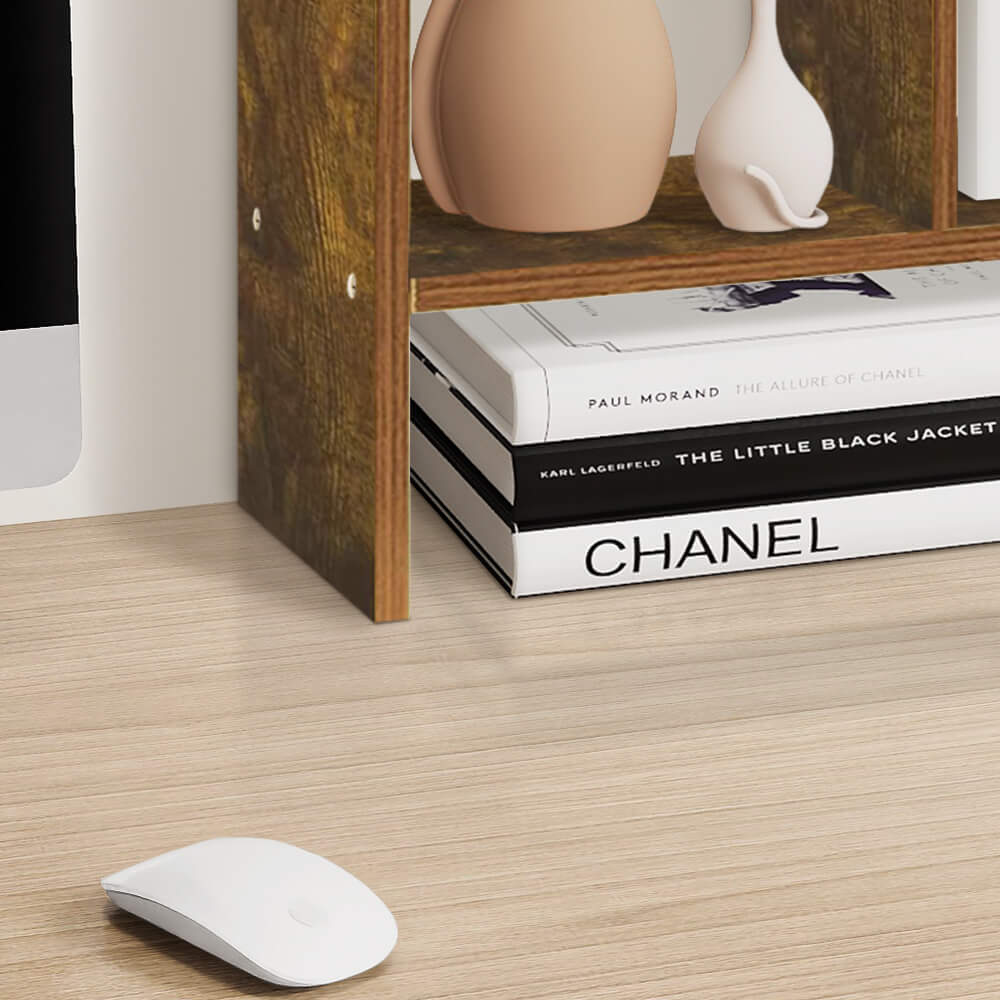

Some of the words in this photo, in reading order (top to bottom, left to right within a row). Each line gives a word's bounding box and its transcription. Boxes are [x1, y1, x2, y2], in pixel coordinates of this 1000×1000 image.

[589, 396, 631, 408] PAUL
[641, 388, 719, 404] MORAND
[736, 382, 764, 395] THE
[768, 376, 828, 392] ALLURE
[835, 373, 854, 384] OF
[861, 368, 924, 382] CHANEL
[541, 469, 575, 478] KARL
[581, 460, 660, 474] LAGERFELD
[675, 450, 723, 465] THE
[734, 441, 811, 459] LITTLE
[822, 432, 897, 450] BLACK
[907, 422, 997, 441] JACKET
[584, 516, 839, 577] CHANEL
